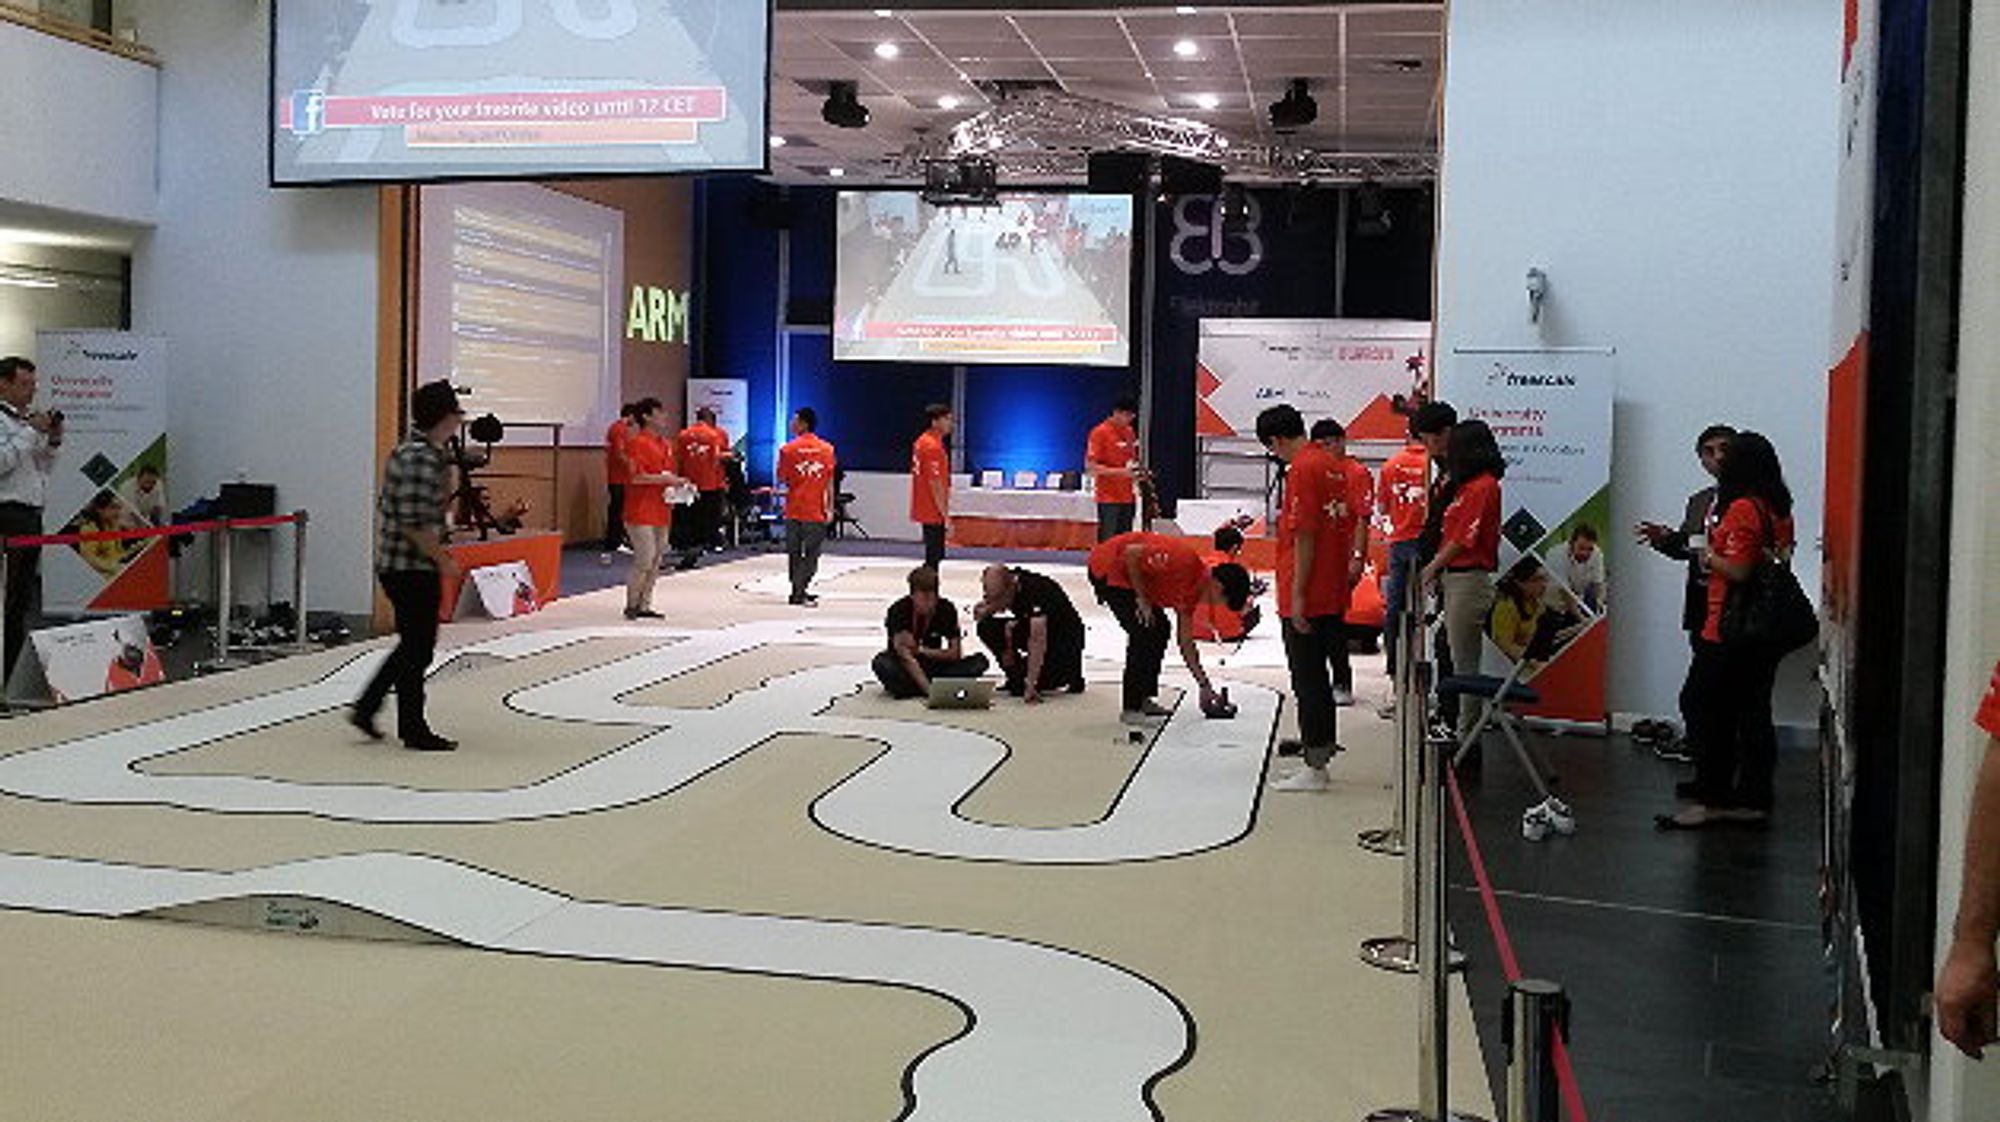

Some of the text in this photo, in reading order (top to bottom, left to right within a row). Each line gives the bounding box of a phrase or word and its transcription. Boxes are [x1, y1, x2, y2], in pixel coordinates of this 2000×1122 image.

[370, 103, 405, 120] Vote
[409, 101, 431, 119] for
[434, 103, 474, 124] your
[476, 99, 539, 118] favorite
[542, 97, 591, 116] video
[594, 97, 634, 116] until
[663, 95, 696, 113] CET
[626, 285, 690, 344] ARM
